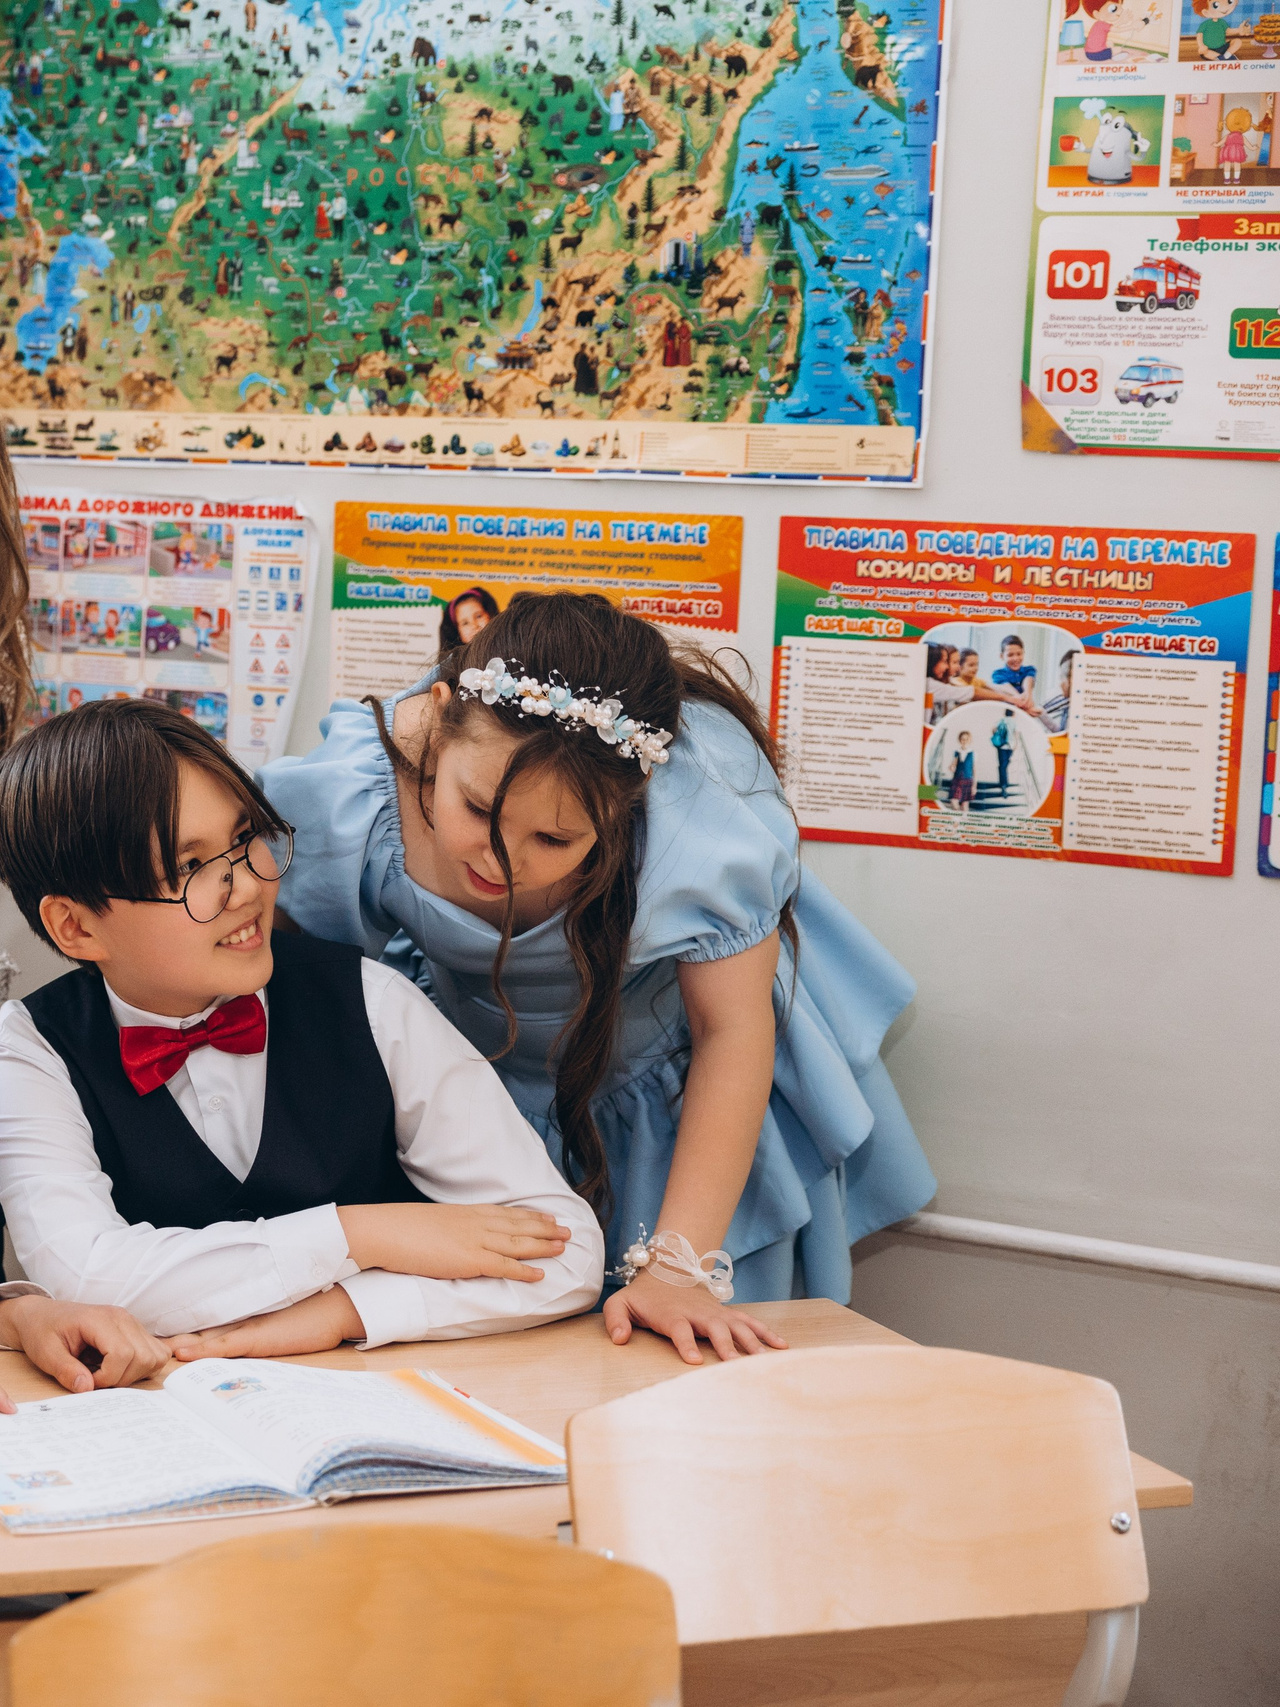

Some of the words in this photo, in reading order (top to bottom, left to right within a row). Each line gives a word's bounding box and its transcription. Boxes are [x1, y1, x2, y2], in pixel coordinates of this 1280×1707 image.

[1100, 65, 1137, 73] ТРОГАЙ
[1209, 62, 1241, 71] ИГРАЙ
[1250, 62, 1276, 70] огнём
[1076, 73, 1146, 82] электроприборы
[346, 165, 484, 186] РОССИЯ
[1057, 190, 1070, 198] НЕ
[1073, 189, 1104, 198] ИГРАЙ
[1192, 188, 1246, 197] ОТКРЫВАЙ
[1248, 190, 1275, 198] дверь
[1237, 198, 1266, 206] людям
[1233, 218, 1280, 235] Зап
[1147, 238, 1249, 254] Телефоны
[1256, 241, 1280, 252] эк
[1052, 261, 1105, 289] 101
[1233, 318, 1280, 348] 112
[1044, 367, 1099, 394] 103
[1255, 373, 1269, 381] 112
[1217, 381, 1238, 389] Если
[1240, 382, 1264, 391] вдруг
[18, 497, 70, 512] ВИЛА
[77, 499, 193, 517] ДОРОЖНОГО
[199, 502, 304, 521] ДВИЖЕНИ
[367, 511, 449, 534] ПРАВИЛА
[457, 515, 566, 538] ПОВЕДЕНИЯ
[574, 521, 602, 540] НА
[610, 521, 709, 545] ПЕРЕМЕНЕ
[507, 545, 528, 554] для
[805, 527, 907, 551] ПРАВИЛА
[917, 529, 1053, 559] ПОВЕДЕНИЯ
[1063, 537, 1097, 560] НА
[1108, 538, 1232, 567] ПЕРЕМЕНЕ
[856, 558, 976, 584] КОРИДОРЫ
[993, 563, 1013, 585] И
[1022, 565, 1154, 593] ЛЕСТНИЦЫ
[1034, 595, 1095, 608] перемене
[805, 615, 905, 636] РАЗРЕШАЕТСЯ
[1102, 632, 1218, 655] ЗАПРЕЩАЕТСЯ
